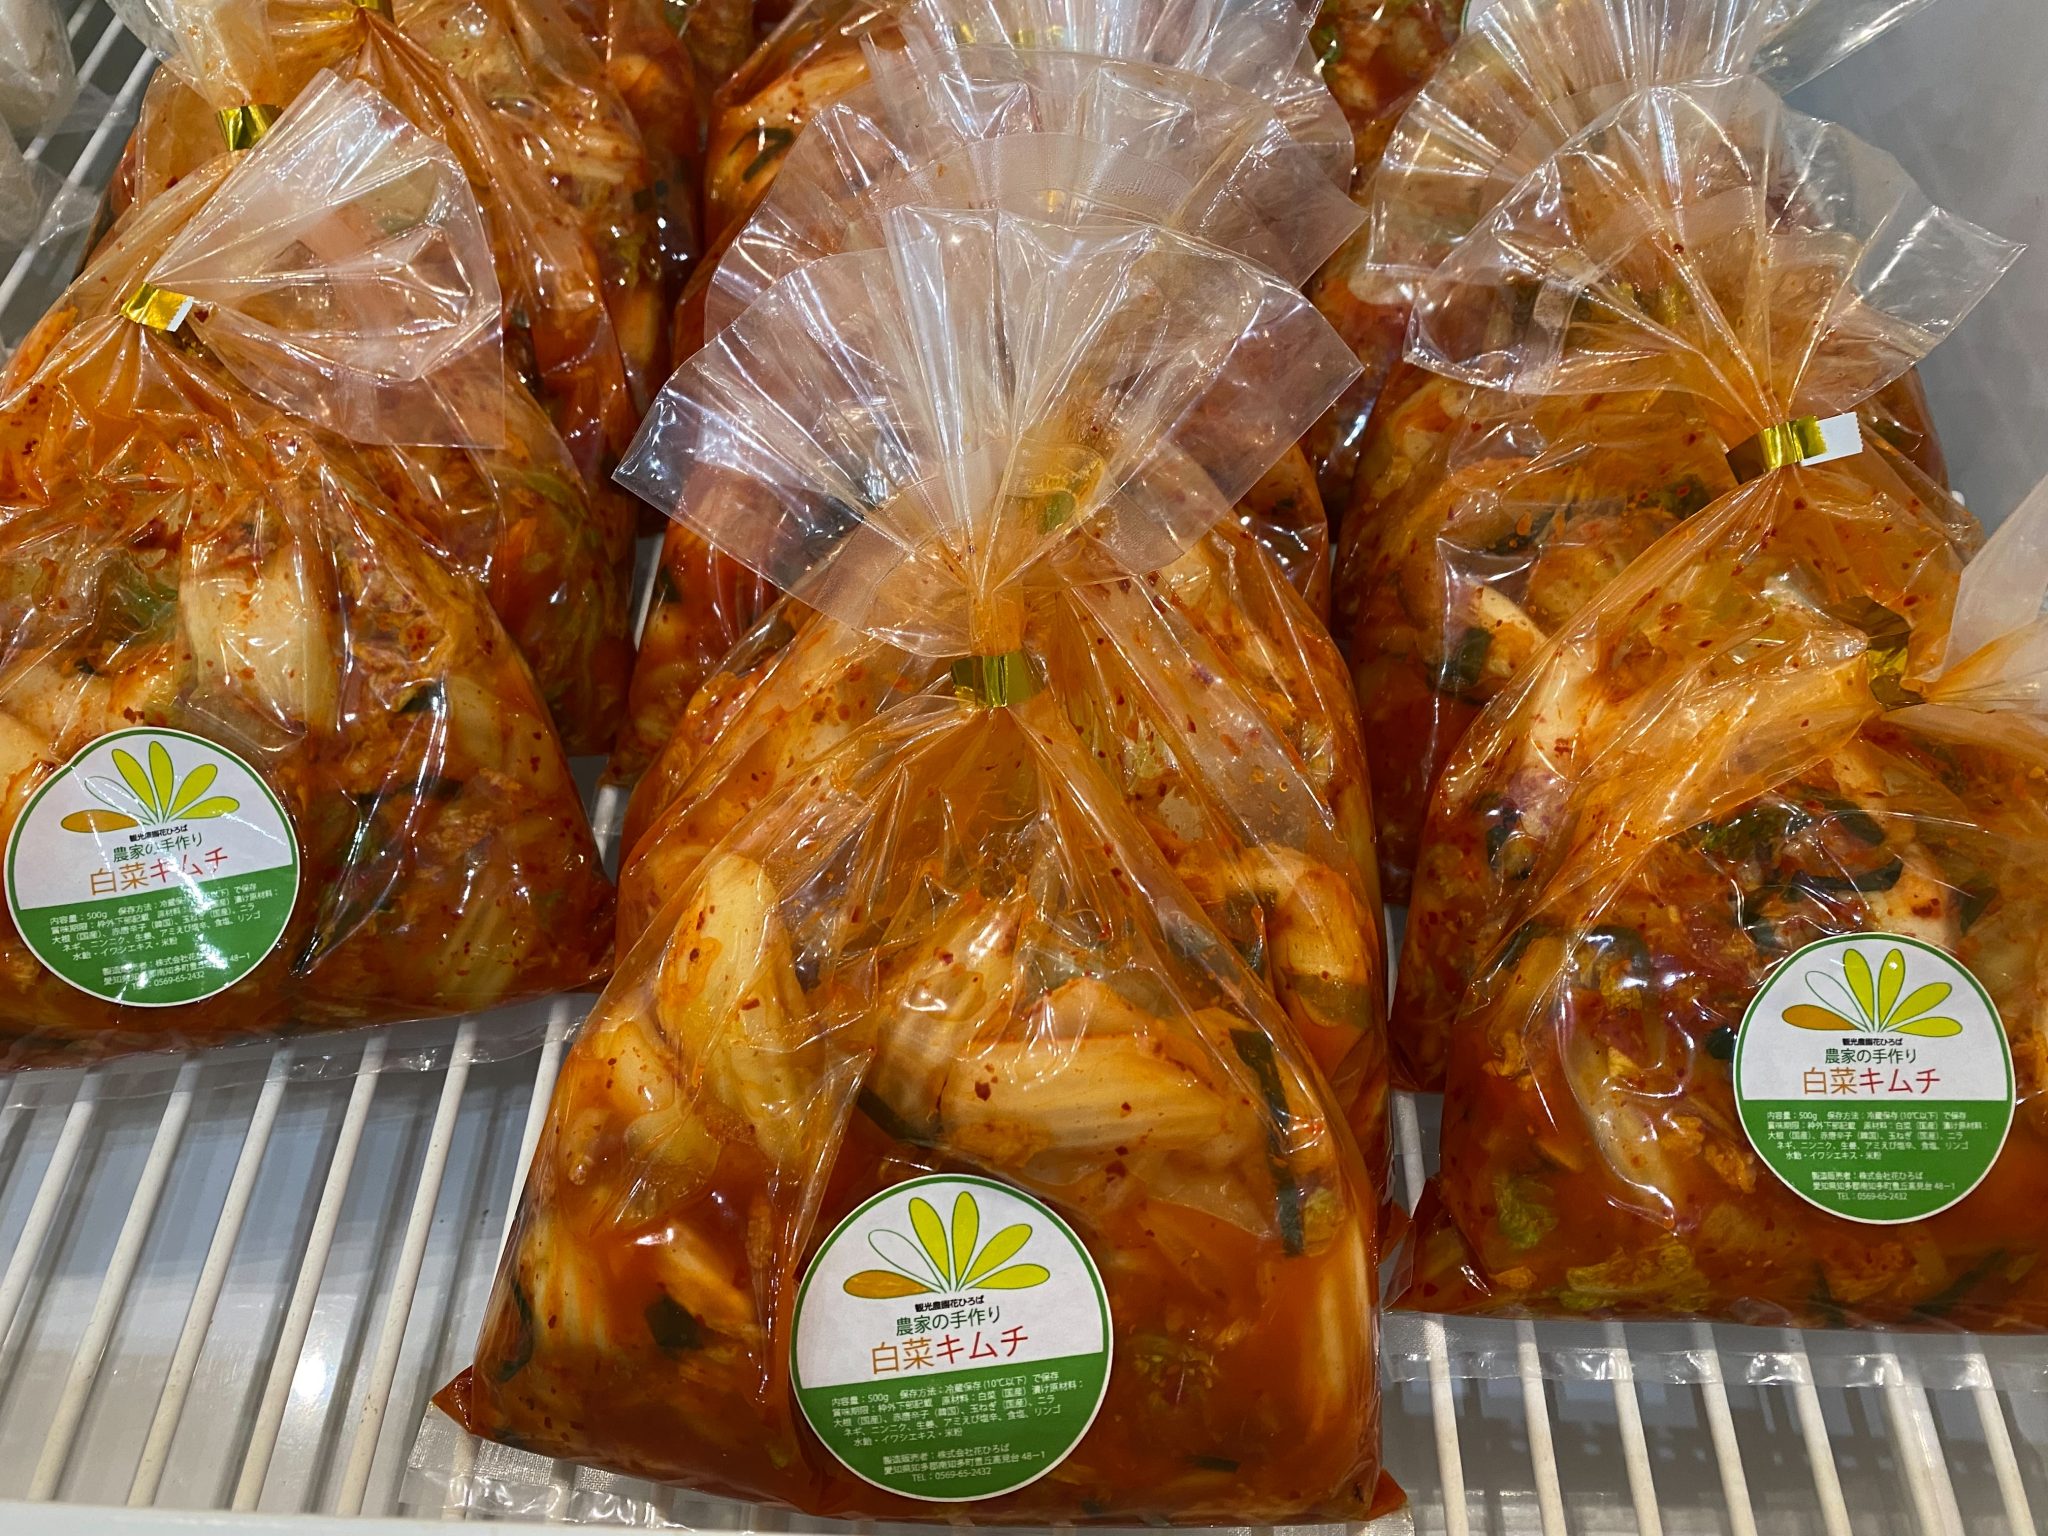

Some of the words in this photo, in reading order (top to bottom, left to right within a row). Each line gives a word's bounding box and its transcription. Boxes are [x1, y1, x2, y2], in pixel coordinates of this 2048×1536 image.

[90, 847, 228, 895] 白菜キムチ
[1825, 1048, 1916, 1064] 農家の手作り
[1803, 1067, 1940, 1094] 白菜キムチ
[915, 1295, 984, 1312] 観光農園花ひろば
[896, 1306, 1000, 1336] 農家の手作り
[871, 1325, 1028, 1374] 白菜キムチ
